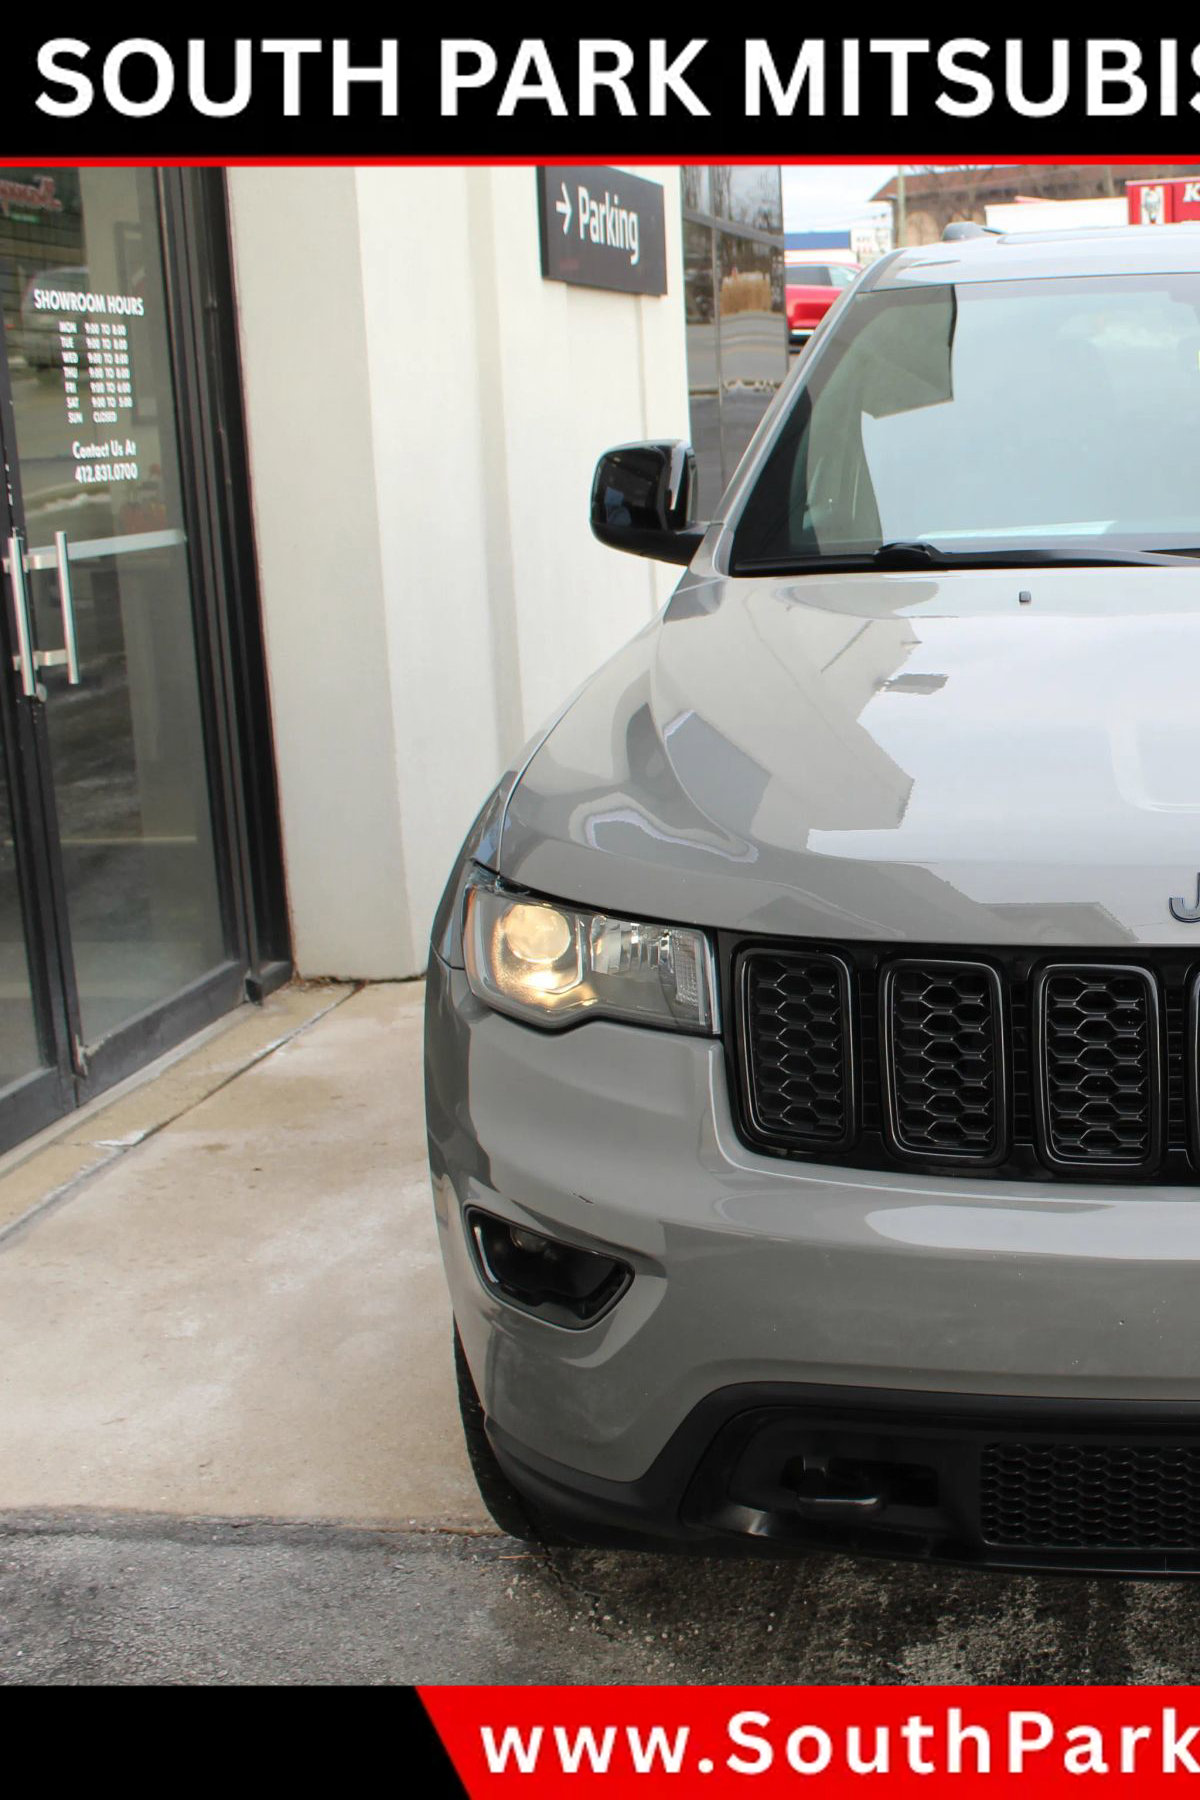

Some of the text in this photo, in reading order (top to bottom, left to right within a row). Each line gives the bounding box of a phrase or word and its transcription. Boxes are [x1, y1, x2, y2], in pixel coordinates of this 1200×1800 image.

[578, 186, 639, 265] Parking
[34, 288, 144, 316] SHOWROOM HOURS
[72, 439, 137, 459] Contact Us At
